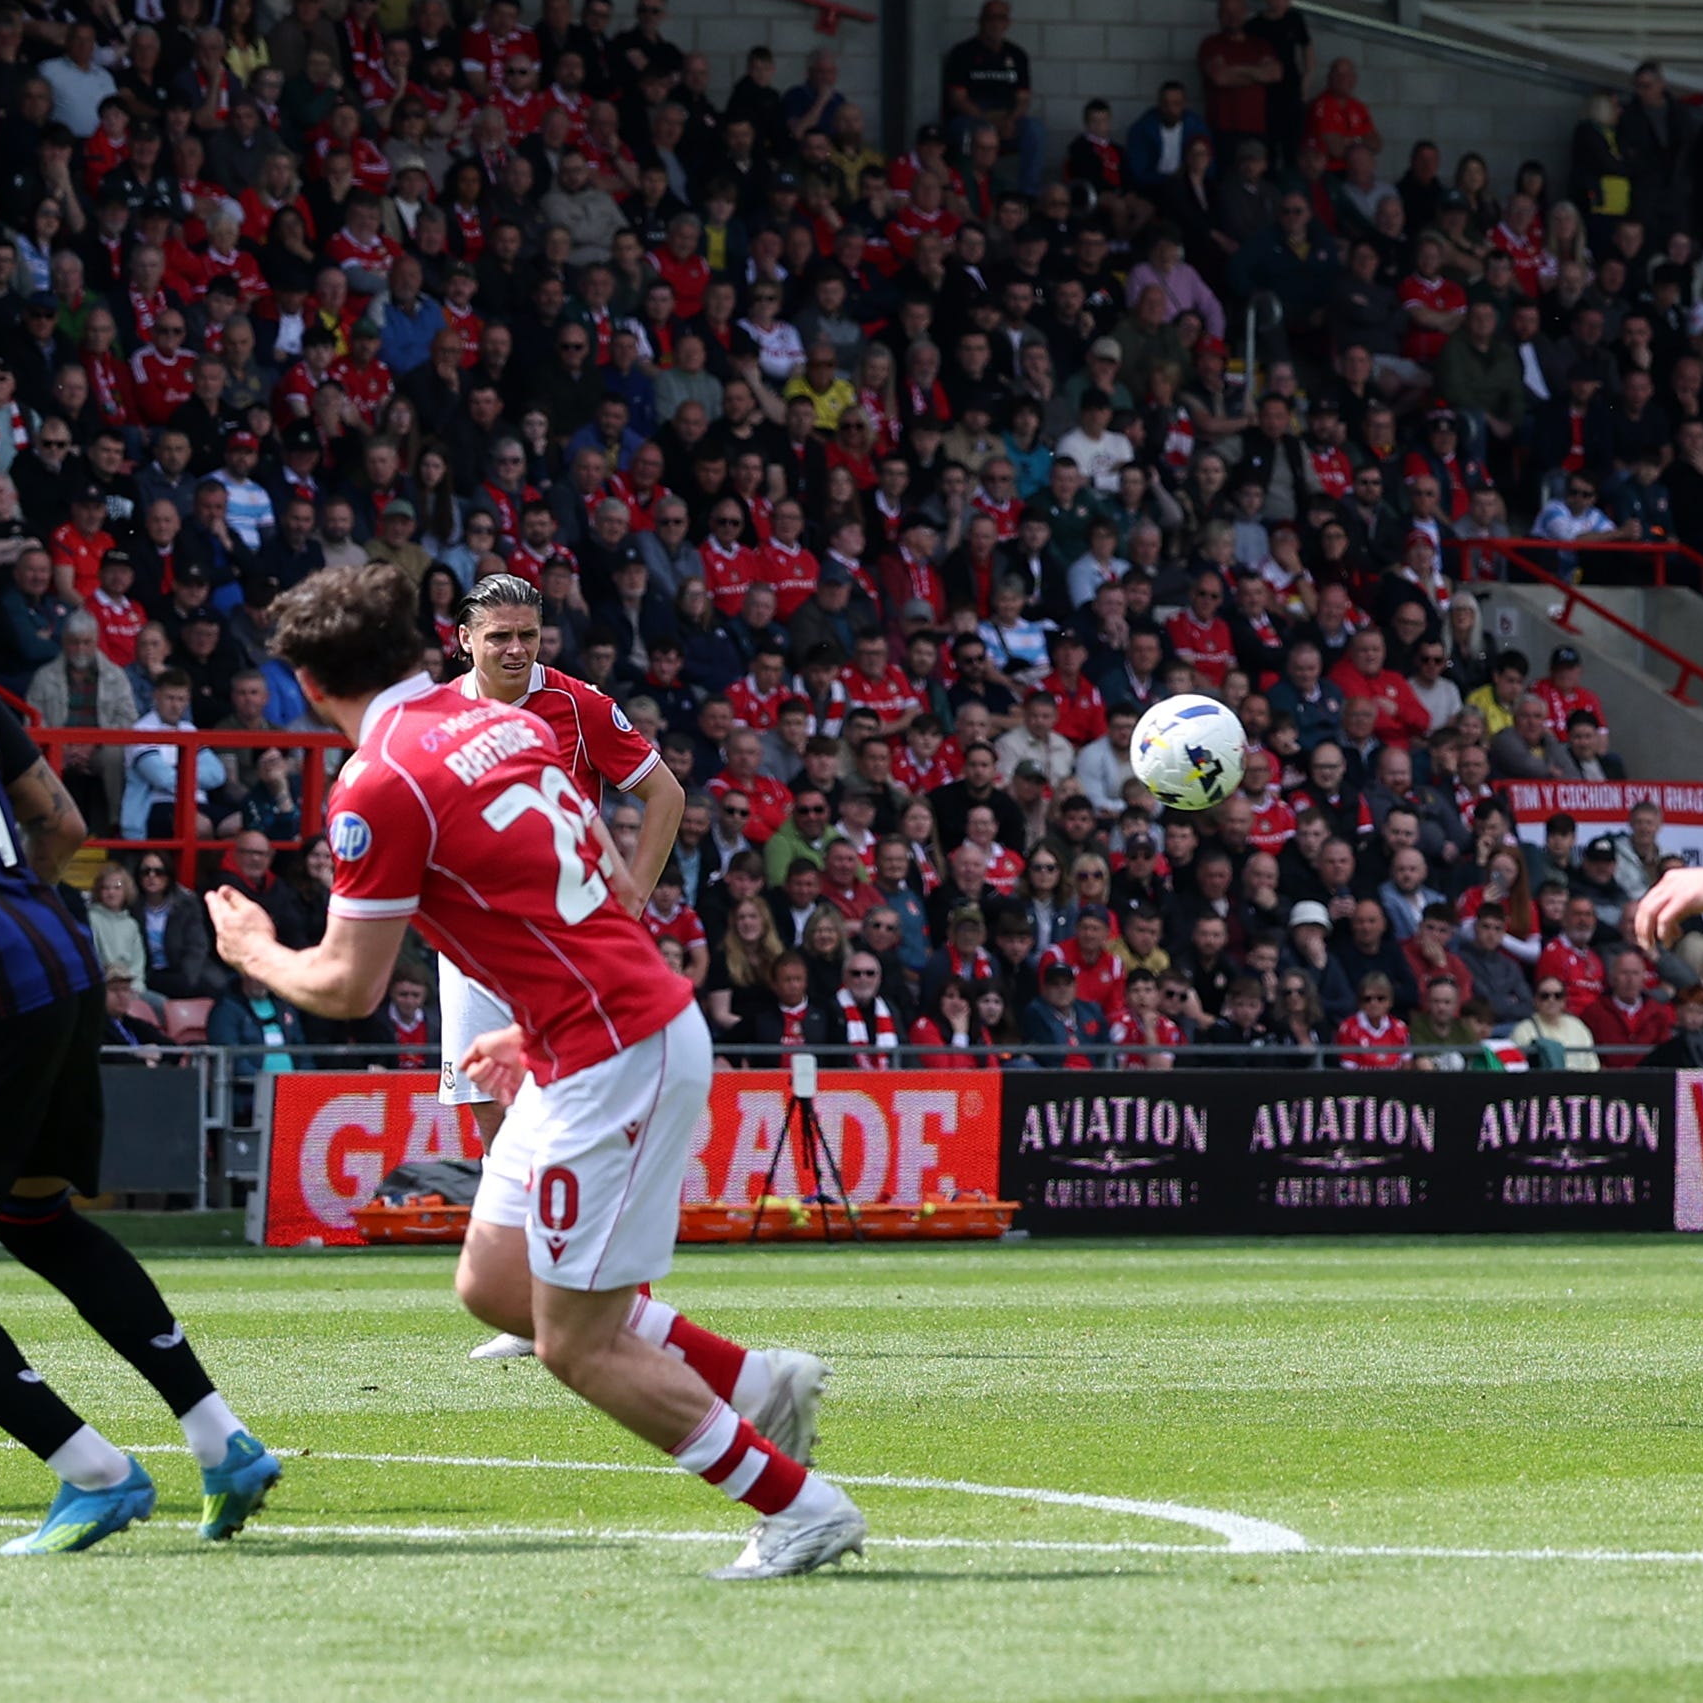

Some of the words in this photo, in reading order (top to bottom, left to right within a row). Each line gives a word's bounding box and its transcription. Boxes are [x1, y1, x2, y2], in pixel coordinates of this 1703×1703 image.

[332, 812, 364, 860] hp
[1017, 1097, 1208, 1153] AVIATION
[1248, 1096, 1435, 1152] AVIATION
[1477, 1095, 1660, 1152] AVIATION
